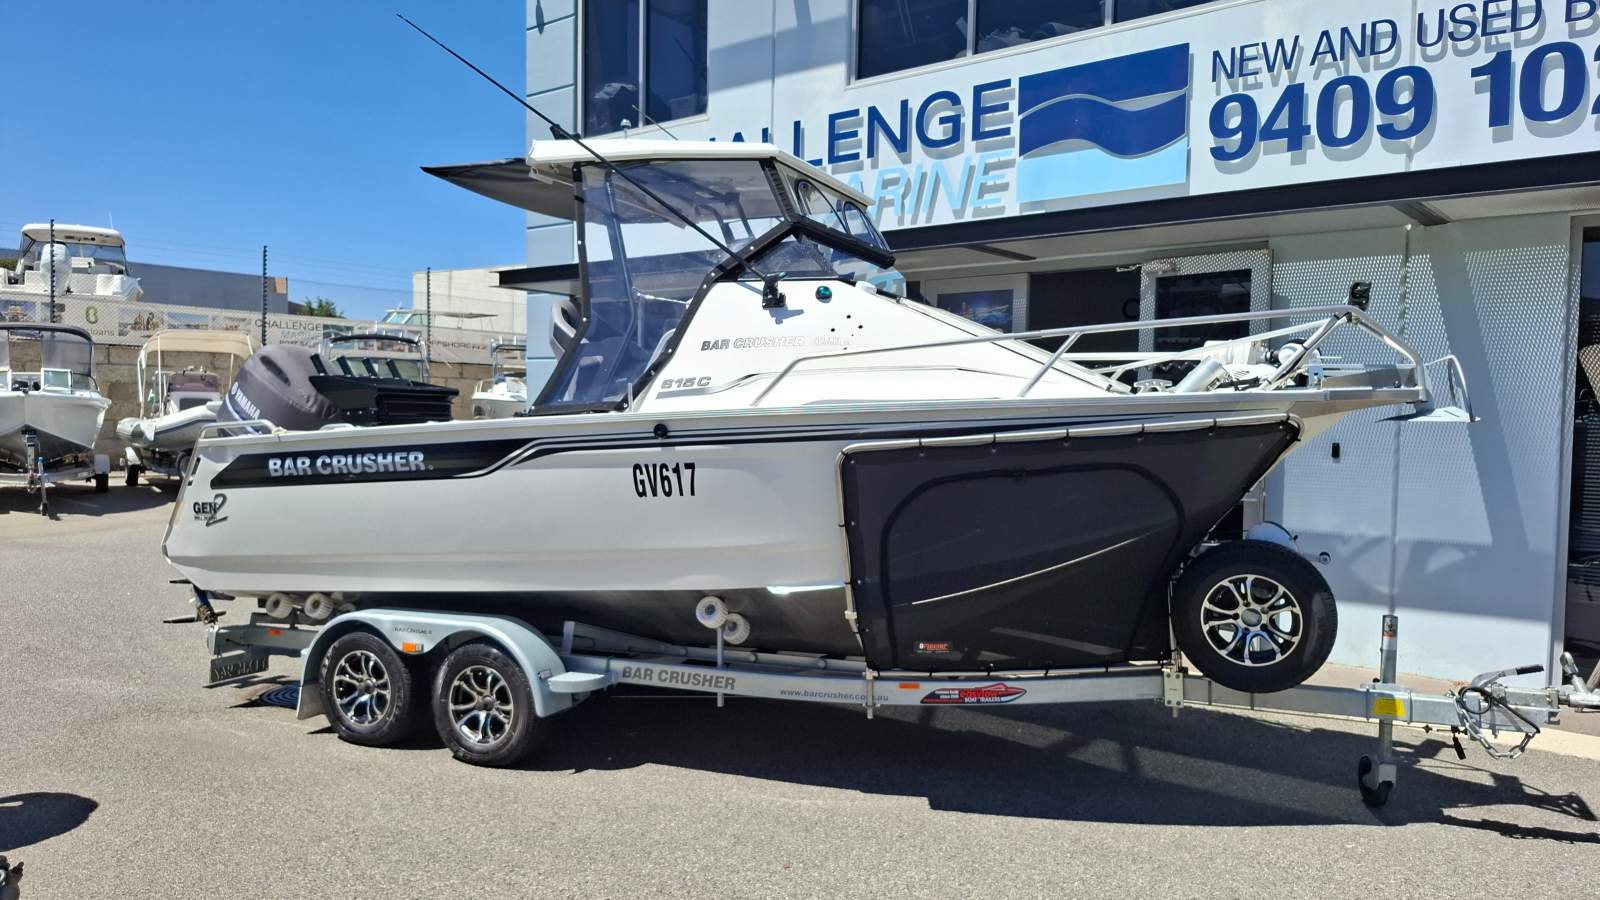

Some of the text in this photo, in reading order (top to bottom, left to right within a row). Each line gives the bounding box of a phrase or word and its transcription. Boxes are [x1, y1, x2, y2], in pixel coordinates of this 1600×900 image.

[1211, 35, 1300, 82] NEW
[1310, 19, 1398, 66] AND
[1416, 0, 1543, 47] USED
[1209, 65, 1434, 162] 9409
[254, 319, 321, 331] CHALLENGE
[701, 338, 731, 351] BAR
[733, 335, 807, 349] CRUSHER
[234, 387, 261, 421] YAMAHA
[268, 451, 426, 477] BAR CRUSHER
[632, 462, 696, 498] GV617
[193, 501, 218, 514] GEN
[622, 666, 736, 690] BAR CRUSHER
